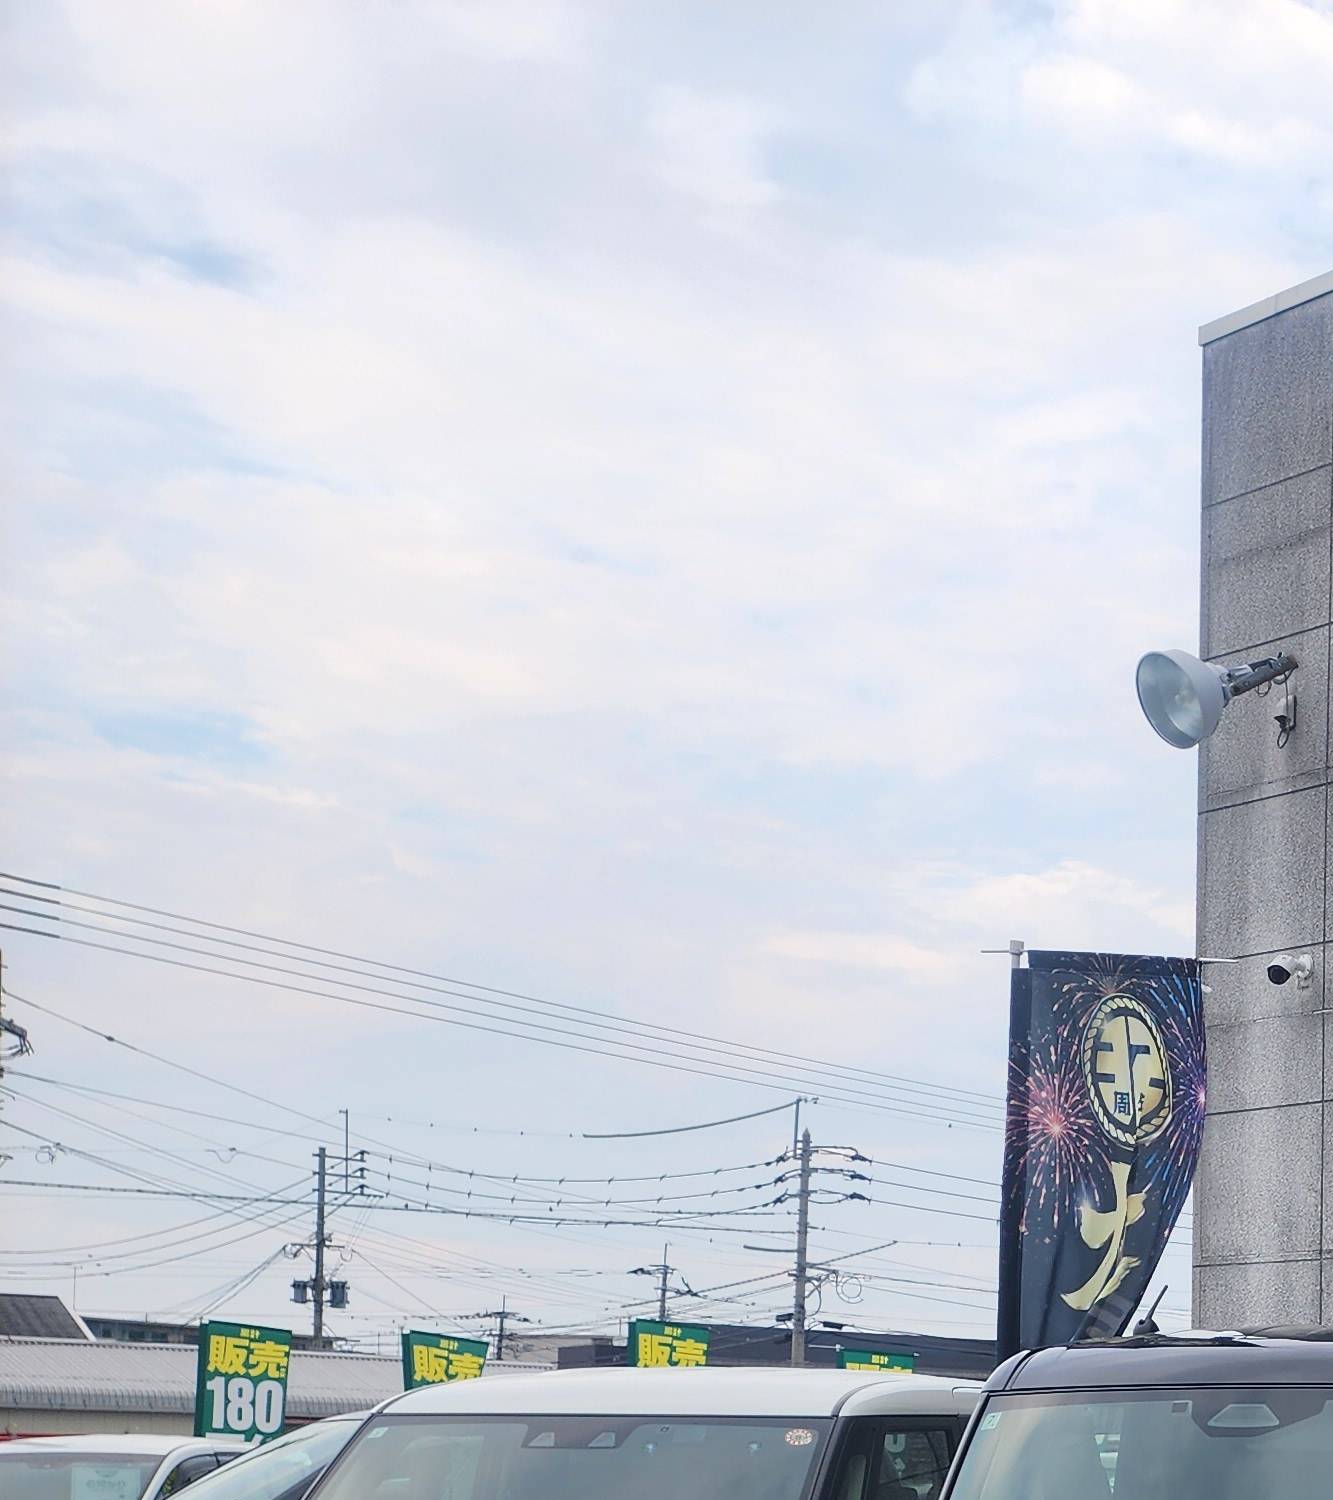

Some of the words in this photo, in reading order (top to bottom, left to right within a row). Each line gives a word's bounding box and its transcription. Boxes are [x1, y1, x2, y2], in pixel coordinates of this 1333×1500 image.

[206, 1334, 289, 1378] 販売
[413, 1344, 484, 1383] 販売
[637, 1333, 708, 1367] 販売
[206, 1375, 284, 1434] 180
